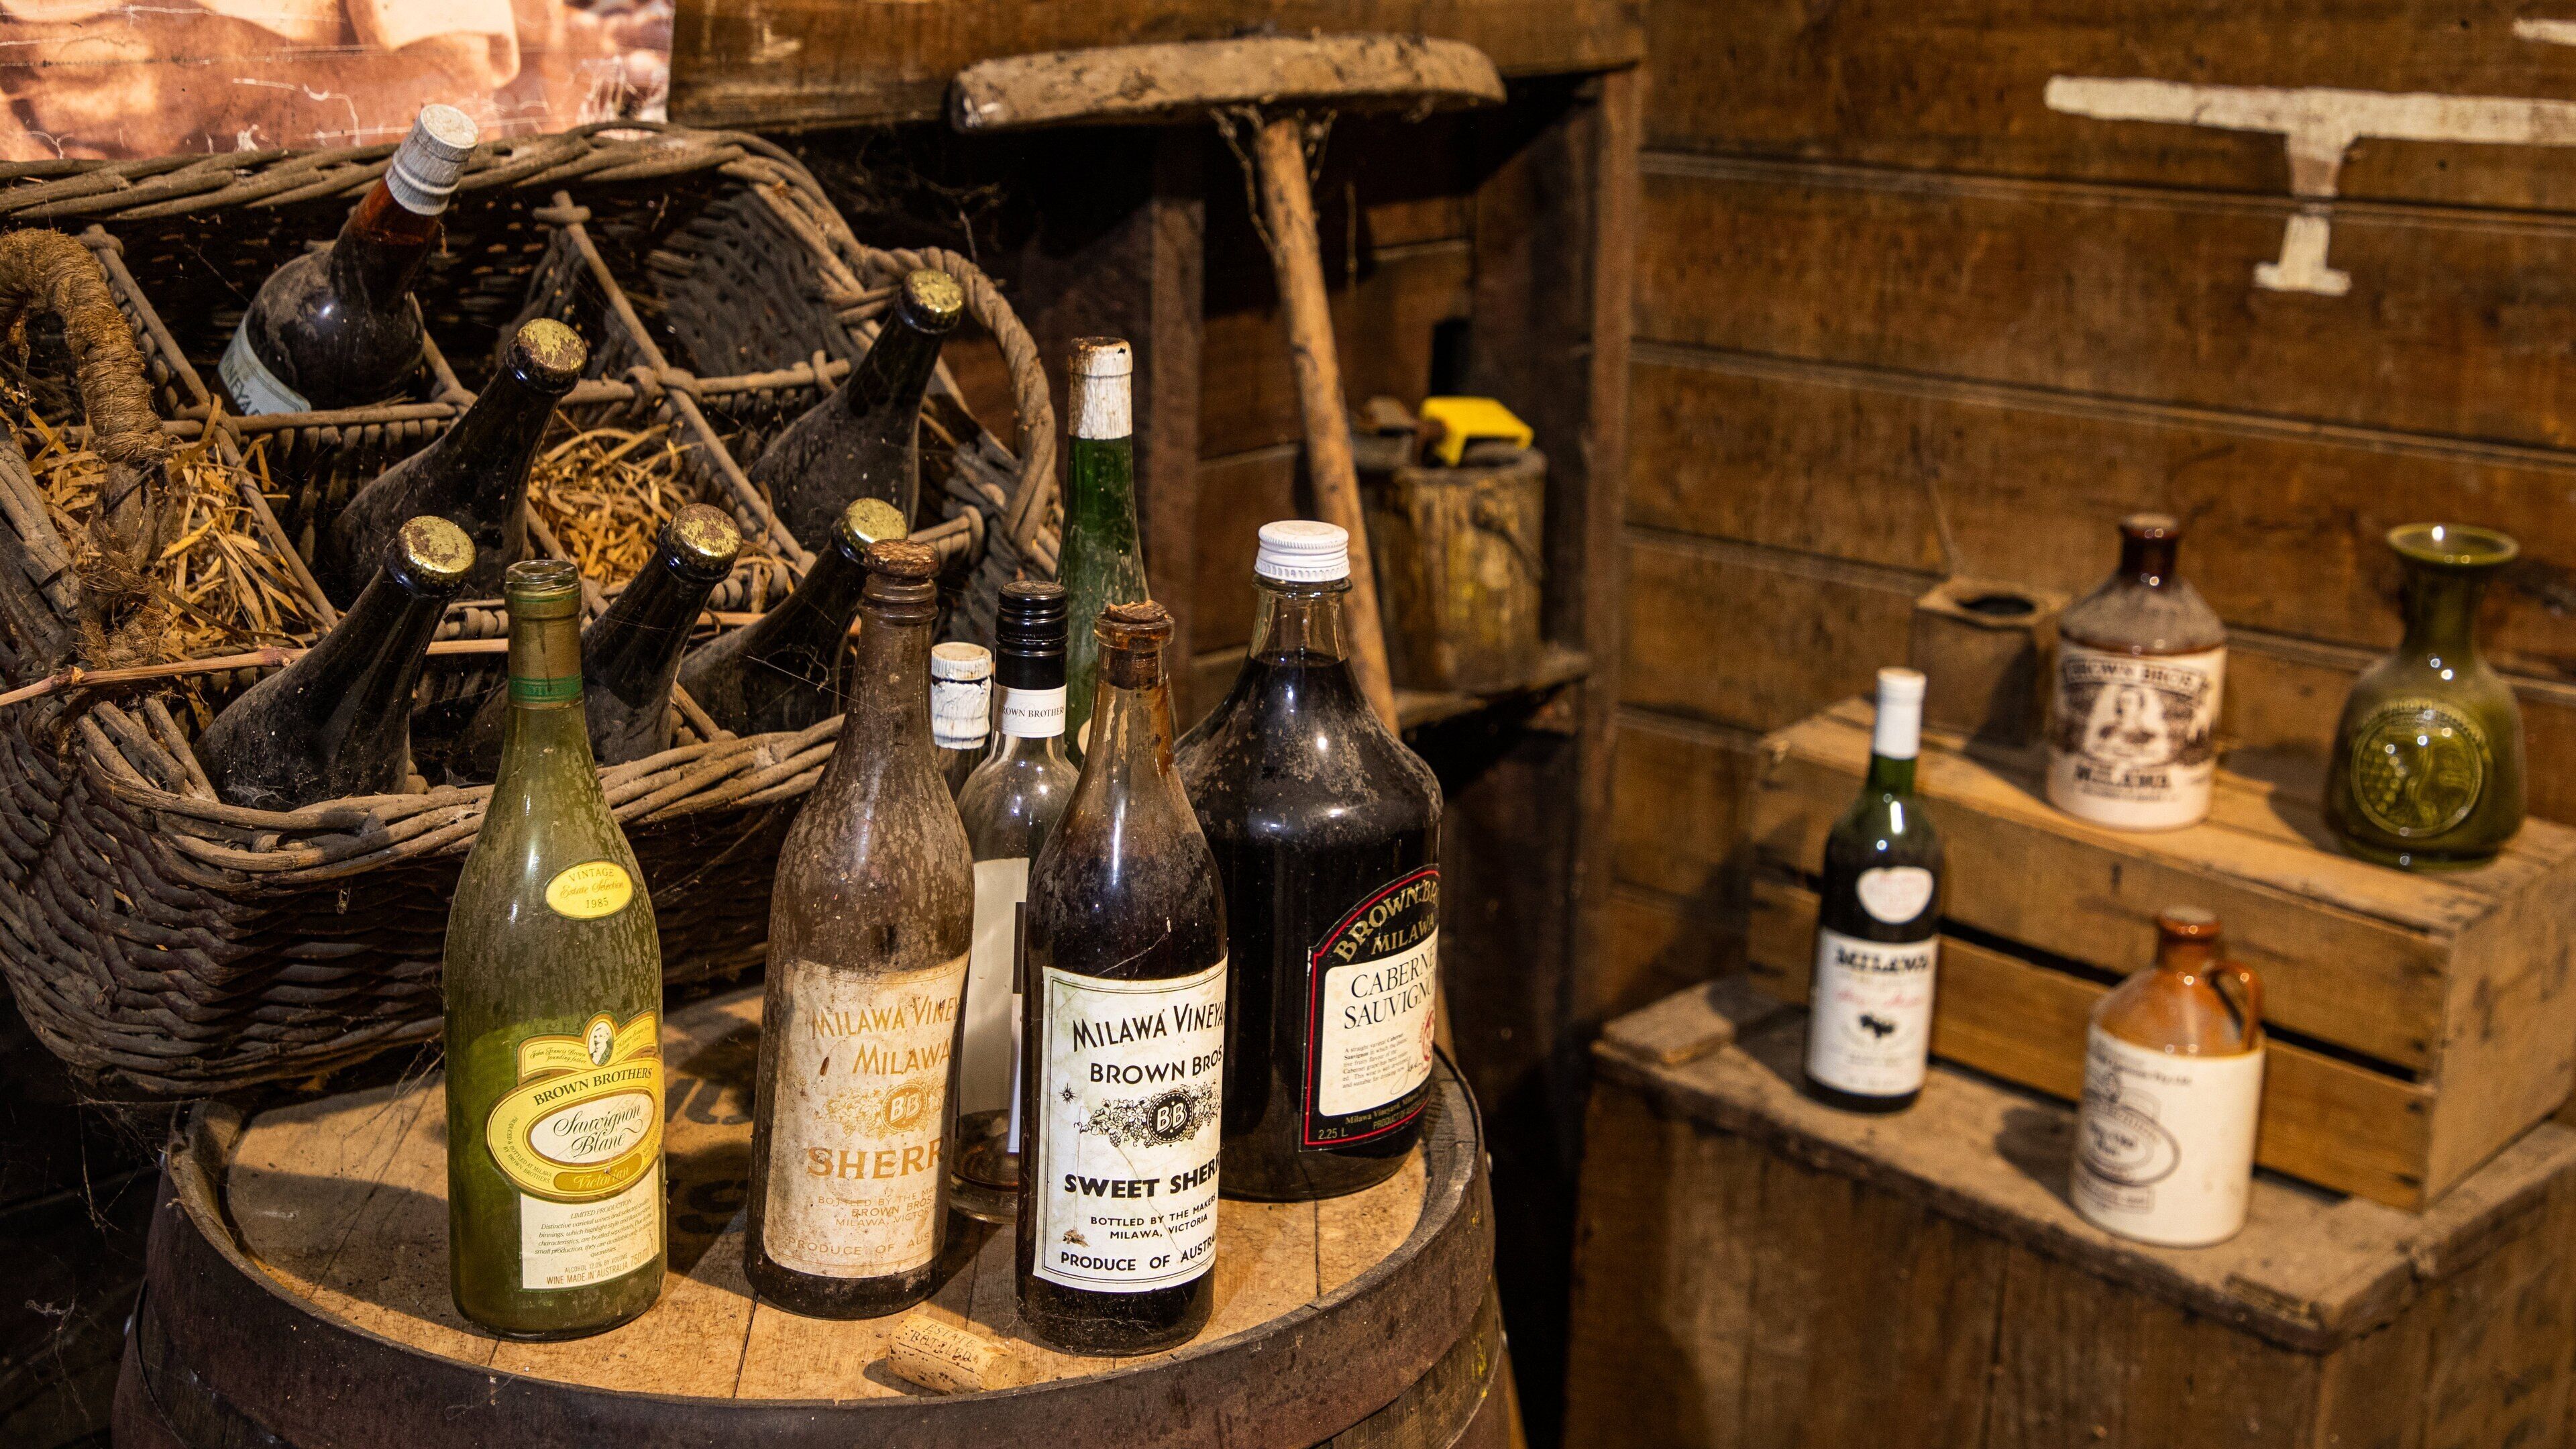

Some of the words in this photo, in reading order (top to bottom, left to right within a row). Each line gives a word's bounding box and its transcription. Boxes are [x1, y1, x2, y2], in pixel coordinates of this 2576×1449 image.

[569, 868, 614, 881] VINTAGE
[560, 885, 589, 899] Estate
[592, 879, 624, 893] Selection
[586, 898, 608, 908] 1985
[1333, 884, 1420, 963] BROWN
[1371, 912, 1434, 955] MILAWA
[812, 1004, 906, 1040] MILAWA
[1073, 1010, 1167, 1052] MILAWA
[1173, 1001, 1226, 1034] VINEYA
[546, 1055, 571, 1063] founding
[568, 1049, 586, 1057] Brown
[852, 1038, 951, 1075] MILAWA
[1090, 1061, 1185, 1085] BROWN
[533, 1079, 590, 1106] BROWN
[593, 1067, 653, 1087] BROTHERS
[553, 1104, 641, 1136] Sauvignon
[890, 1093, 922, 1124] BB
[1157, 1103, 1187, 1132] BB
[507, 1116, 519, 1140] PRODUCED
[572, 1119, 643, 1158] Blanc
[1318, 1128, 1338, 1140] 2.25
[1342, 1127, 1348, 1137] L
[510, 1145, 527, 1165] BOTTLED
[806, 1137, 944, 1179] SHERR
[508, 1154, 523, 1170] BROWN
[523, 1169, 551, 1183] BROTHERS
[533, 1166, 553, 1178] MILAWA
[574, 1167, 629, 1189] Victorian
[1065, 1174, 1160, 1198] SWEET
[570, 1210, 596, 1219] LIMITED
[596, 1199, 632, 1214] PRODUCTION
[818, 1196, 871, 1206] BOTTLED
[878, 1197, 892, 1205] BY
[898, 1193, 916, 1203] THE
[851, 1207, 900, 1217] BROWN
[907, 1195, 934, 1212] BROS.
[1091, 1217, 1144, 1226] BOTTLED
[1150, 1216, 1164, 1224] BY
[1170, 1210, 1189, 1221] THE
[1193, 1193, 1216, 1215] MAKERS
[572, 1219, 594, 1228] varietal
[584, 1224, 607, 1234] highlight
[608, 1220, 619, 1229] style
[619, 1216, 629, 1224] and
[1110, 1230, 1163, 1240] MILAWA,
[1169, 1214, 1208, 1234] VICTORIA
[551, 1247, 583, 1255] production,
[606, 1234, 629, 1245] available
[591, 1232, 610, 1240] bottled
[788, 1236, 861, 1255] PRODUCE
[875, 1244, 896, 1254] OF
[565, 1265, 586, 1273] ALCOHOL
[612, 1253, 628, 1263] VOLUME
[1061, 1252, 1136, 1271] PRODUCE
[1150, 1255, 1171, 1269] OF
[546, 1276, 564, 1285] WINE
[567, 1273, 585, 1283] MADE
[588, 1271, 594, 1279] IN
[596, 1262, 628, 1278] AUSTRALIA
[909, 1330, 971, 1362] BOTTLED
[925, 1323, 977, 1350] ESTATE
